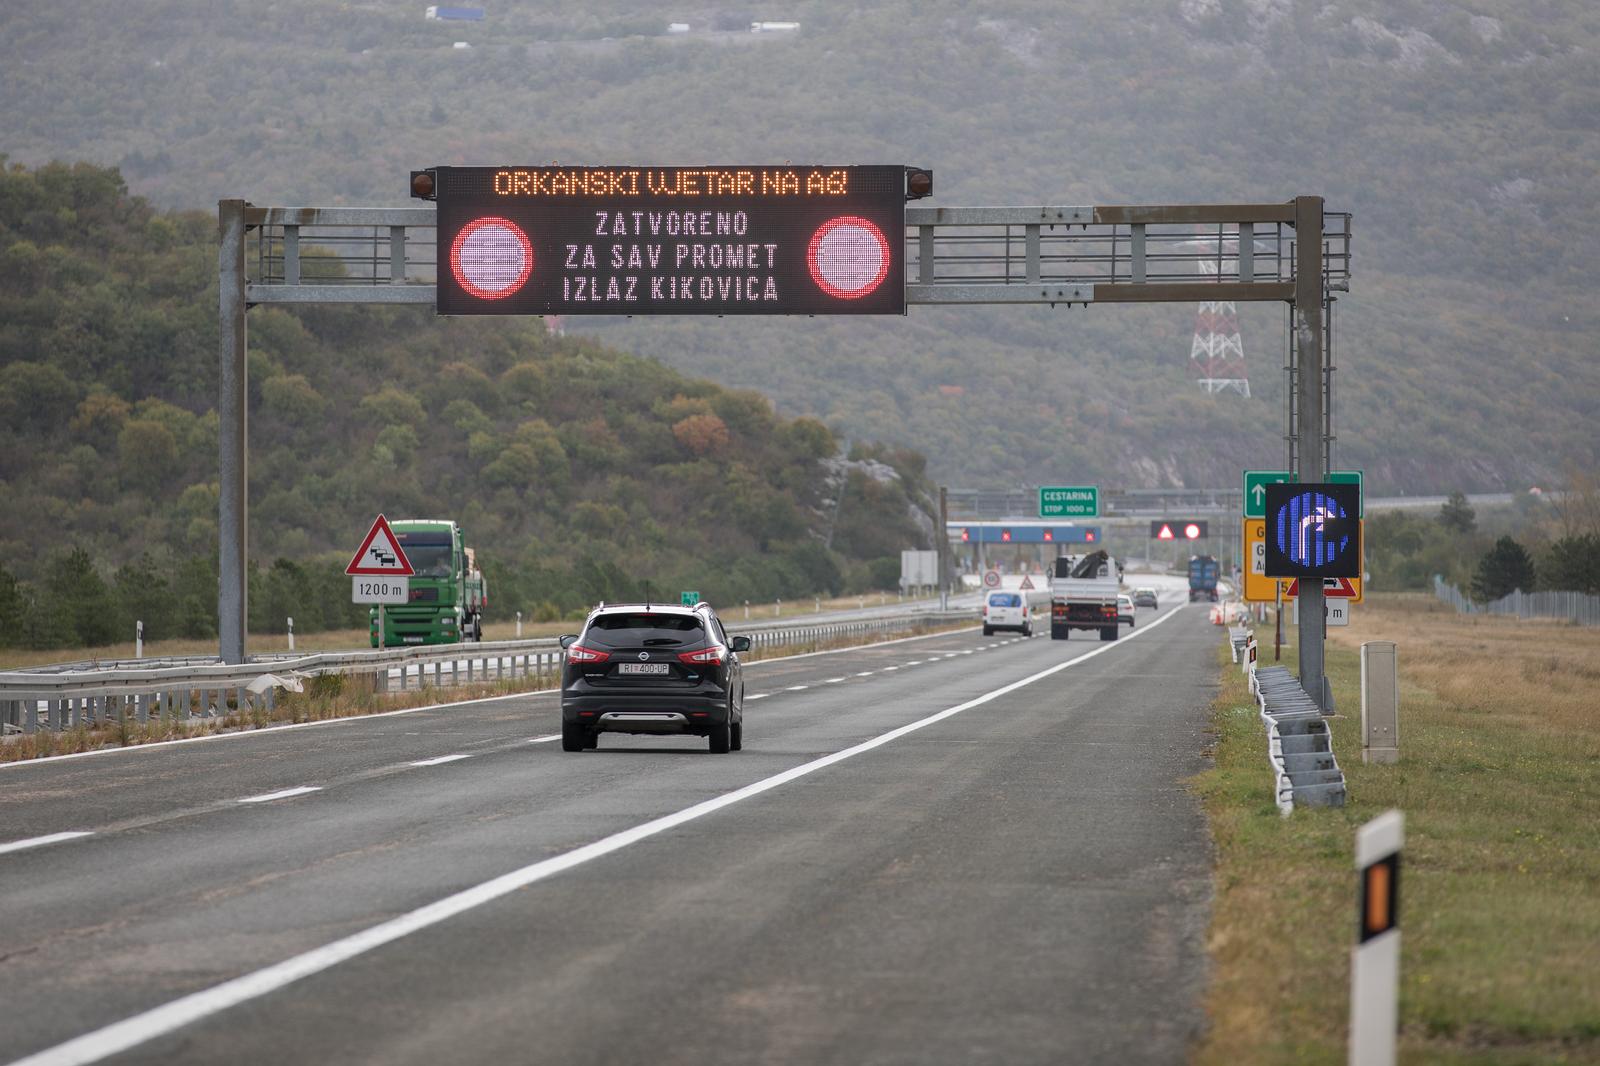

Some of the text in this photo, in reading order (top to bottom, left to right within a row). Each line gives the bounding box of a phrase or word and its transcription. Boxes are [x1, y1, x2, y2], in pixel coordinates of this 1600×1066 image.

[495, 171, 640, 195] ORKANSKI
[763, 171, 799, 195] NA
[595, 211, 748, 235] ZATVORENO
[565, 244, 778, 269] ZA SAV PROMET
[563, 276, 778, 301] IZLAZ KIKOVICA
[1044, 491, 1094, 501] CESTARINA
[1044, 505, 1063, 513] STOP
[1066, 505, 1085, 513] 1000
[360, 583, 389, 596] 1200
[392, 586, 402, 596] m
[1332, 608, 1343, 618] m
[624, 664, 634, 673] RI
